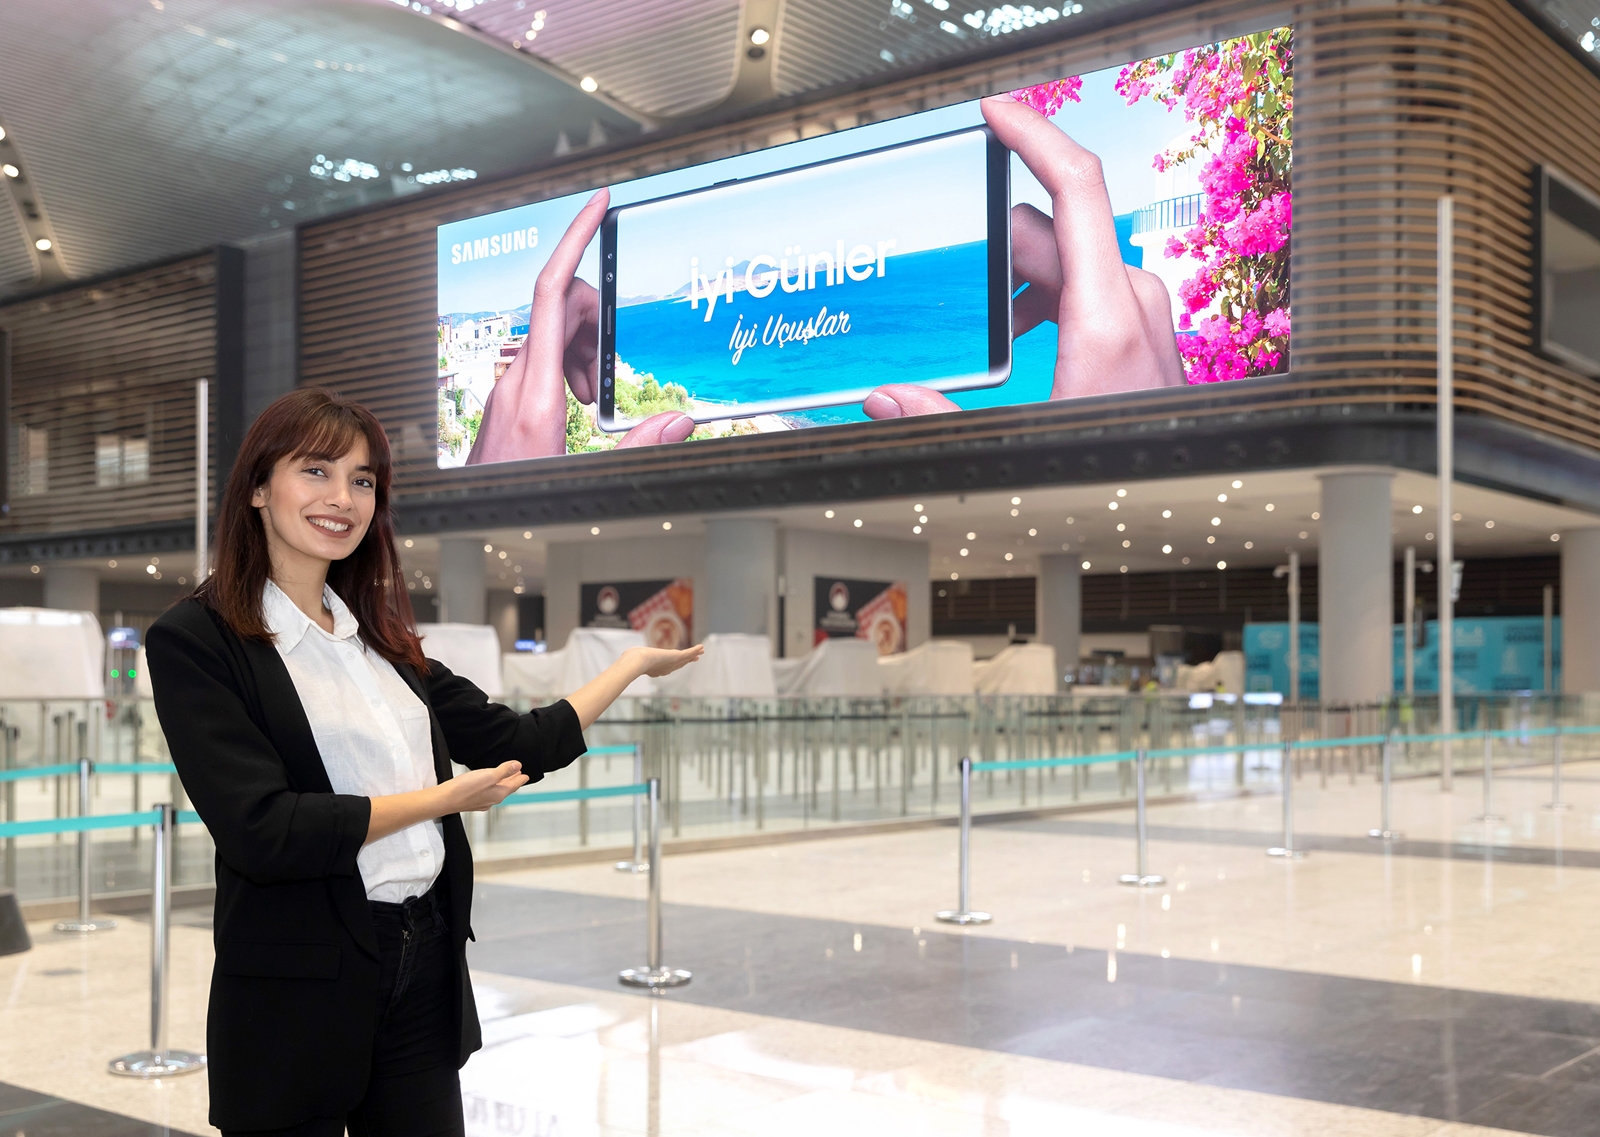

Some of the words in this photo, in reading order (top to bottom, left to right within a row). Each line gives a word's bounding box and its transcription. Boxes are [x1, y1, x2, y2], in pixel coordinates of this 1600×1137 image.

[451, 226, 539, 265] SAMSUNG
[690, 256, 734, 323] İyi
[745, 239, 897, 298] Günler
[728, 313, 758, 366] İyi
[762, 306, 851, 349] Uçuşlar
